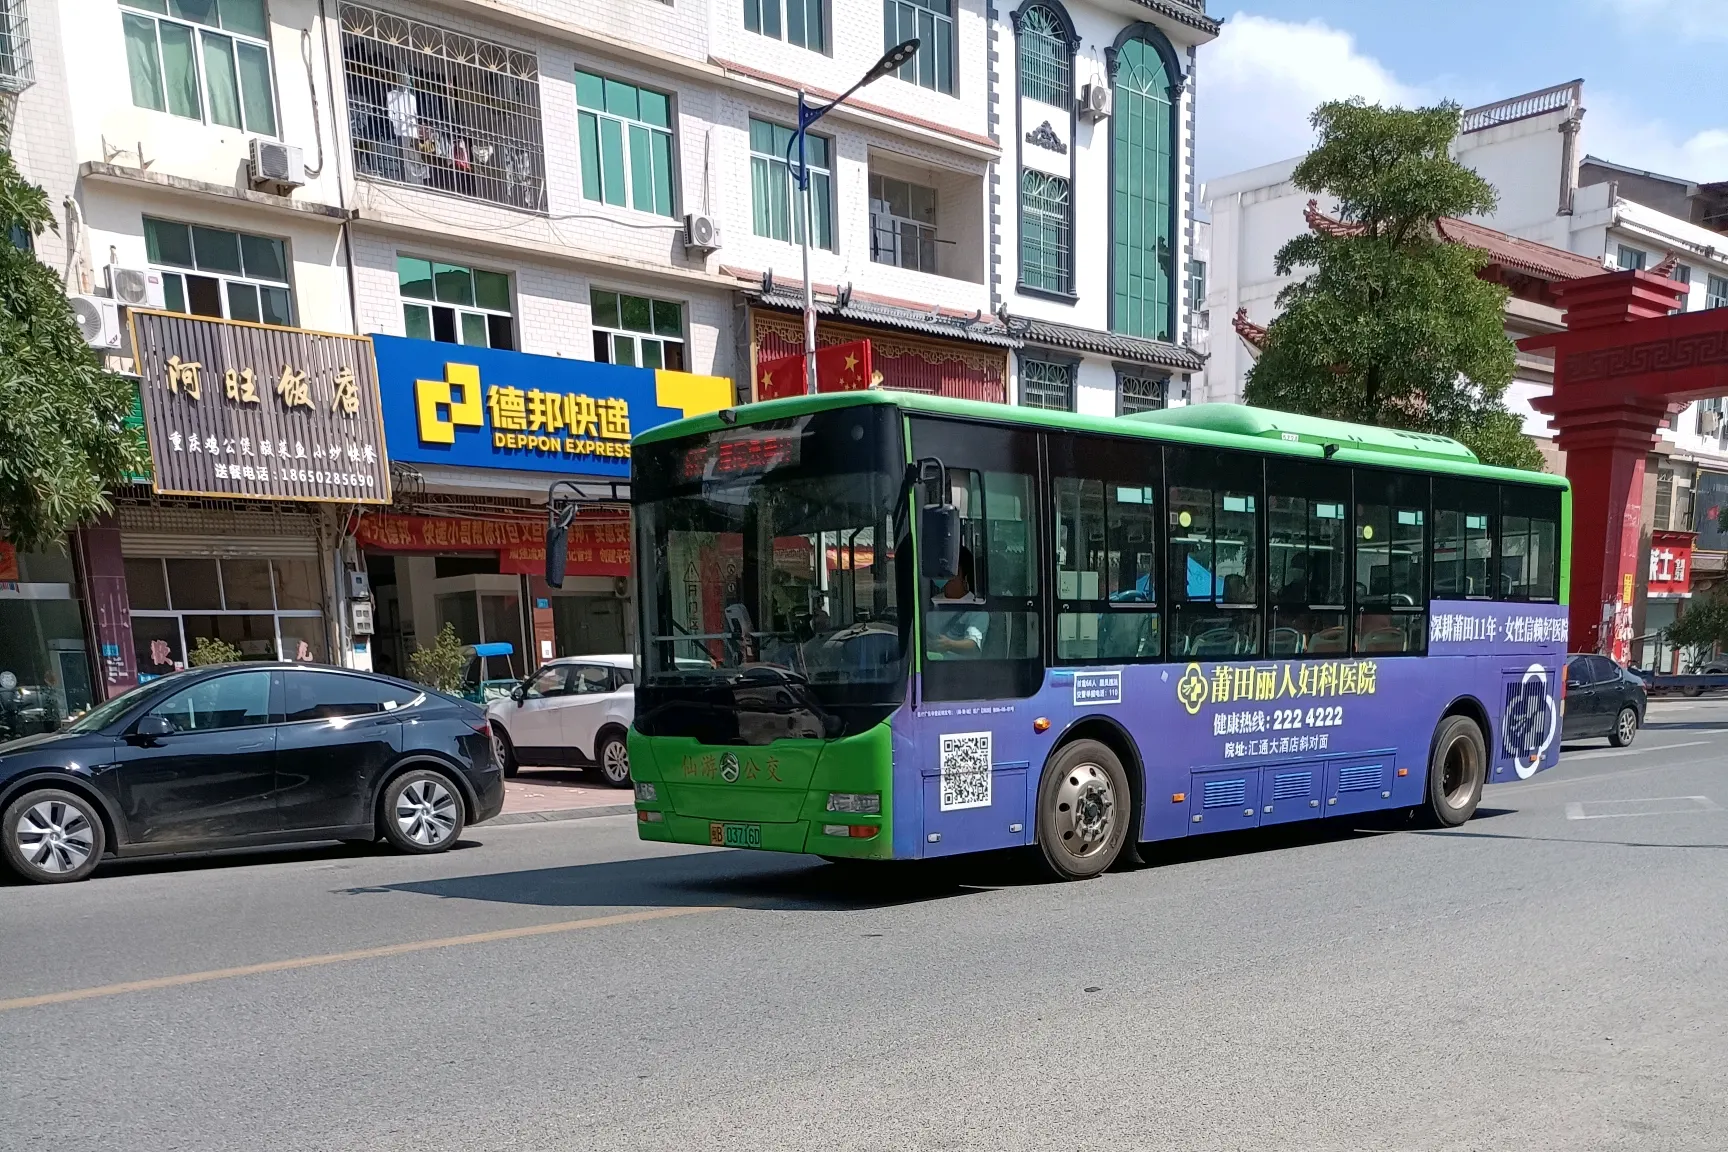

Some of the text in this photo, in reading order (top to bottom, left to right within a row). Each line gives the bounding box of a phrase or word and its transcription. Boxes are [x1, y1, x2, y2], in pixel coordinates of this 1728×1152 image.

[167, 355, 360, 413] 阿旺饭店
[487, 385, 632, 439] 德邦快递
[494, 433, 631, 458] DEPPON EXPRESS
[1211, 661, 1377, 703] 莆田丽人妇科医院
[1224, 733, 1329, 758] 院址：汇通大酒店斜对面
[682, 754, 782, 783] 仙游 公交
